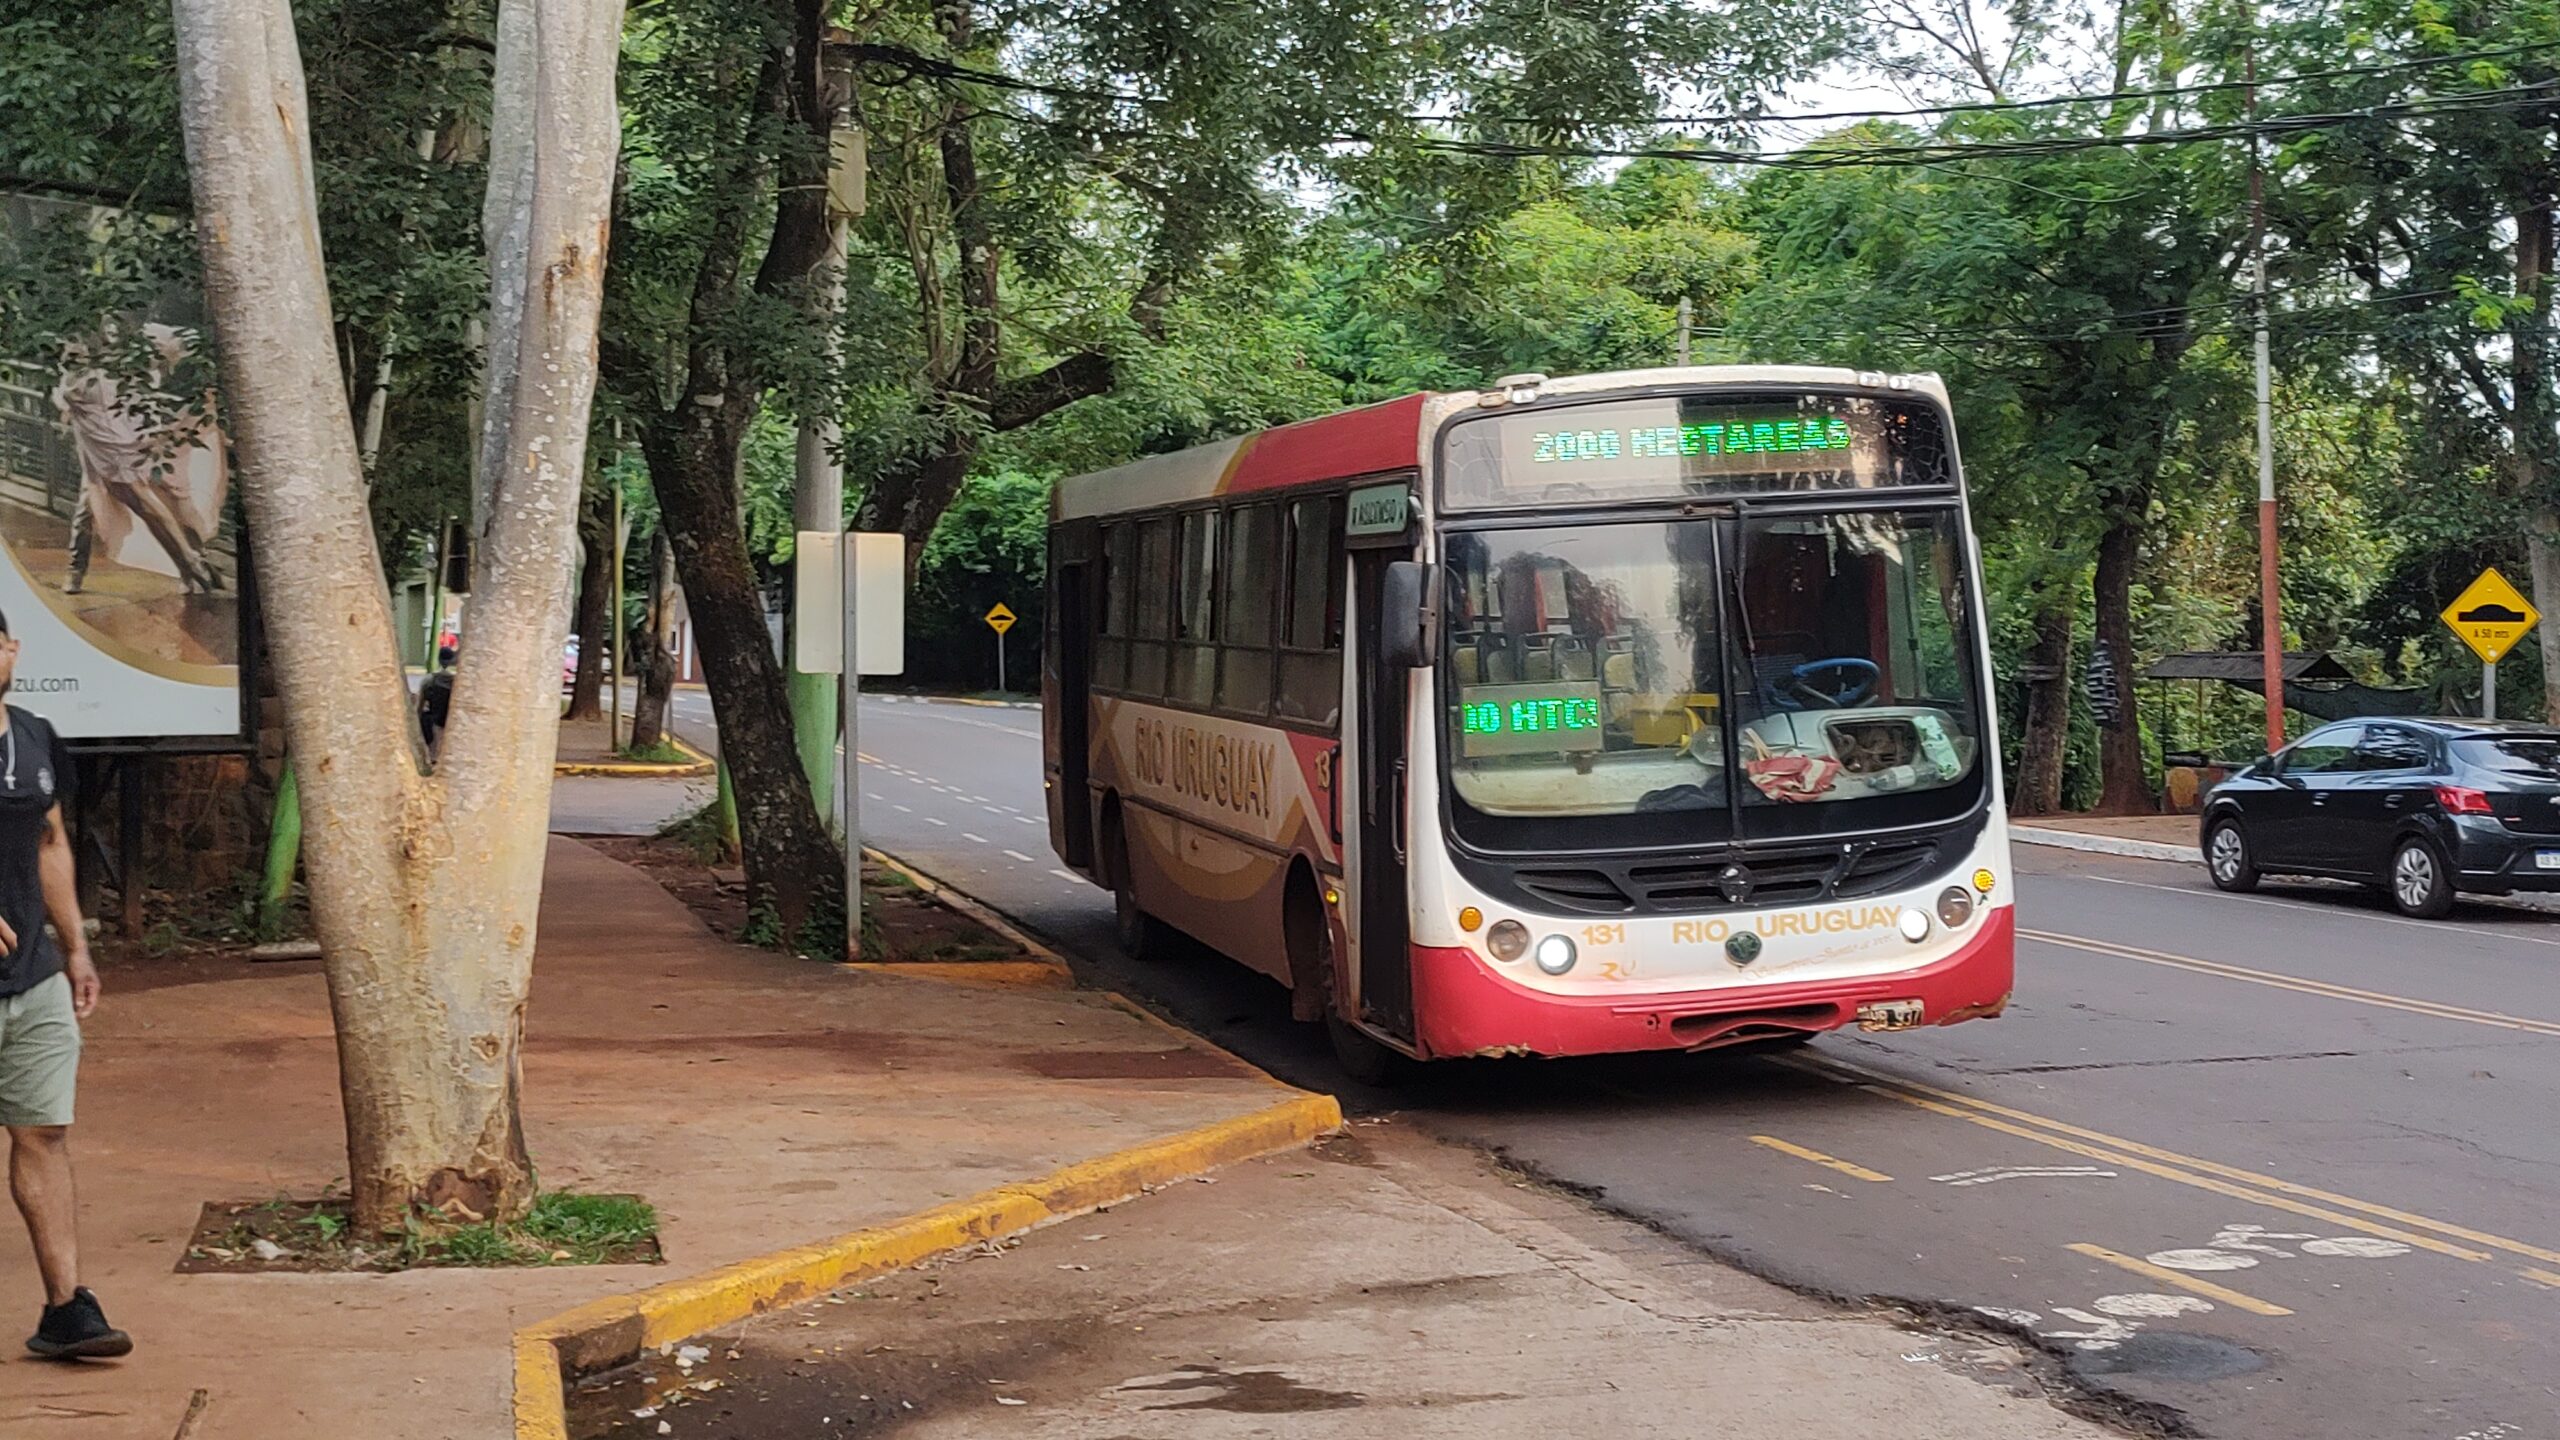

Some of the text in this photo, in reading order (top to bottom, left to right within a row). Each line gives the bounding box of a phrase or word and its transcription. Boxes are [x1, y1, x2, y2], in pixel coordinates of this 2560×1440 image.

[1533, 418, 1850, 462] 2000 HECTAREAS
[15, 678, 80, 693] zu.com
[1135, 717, 1277, 820] RIO URUGUAY
[1582, 904, 1901, 946] 131 RIO URUGUAY
